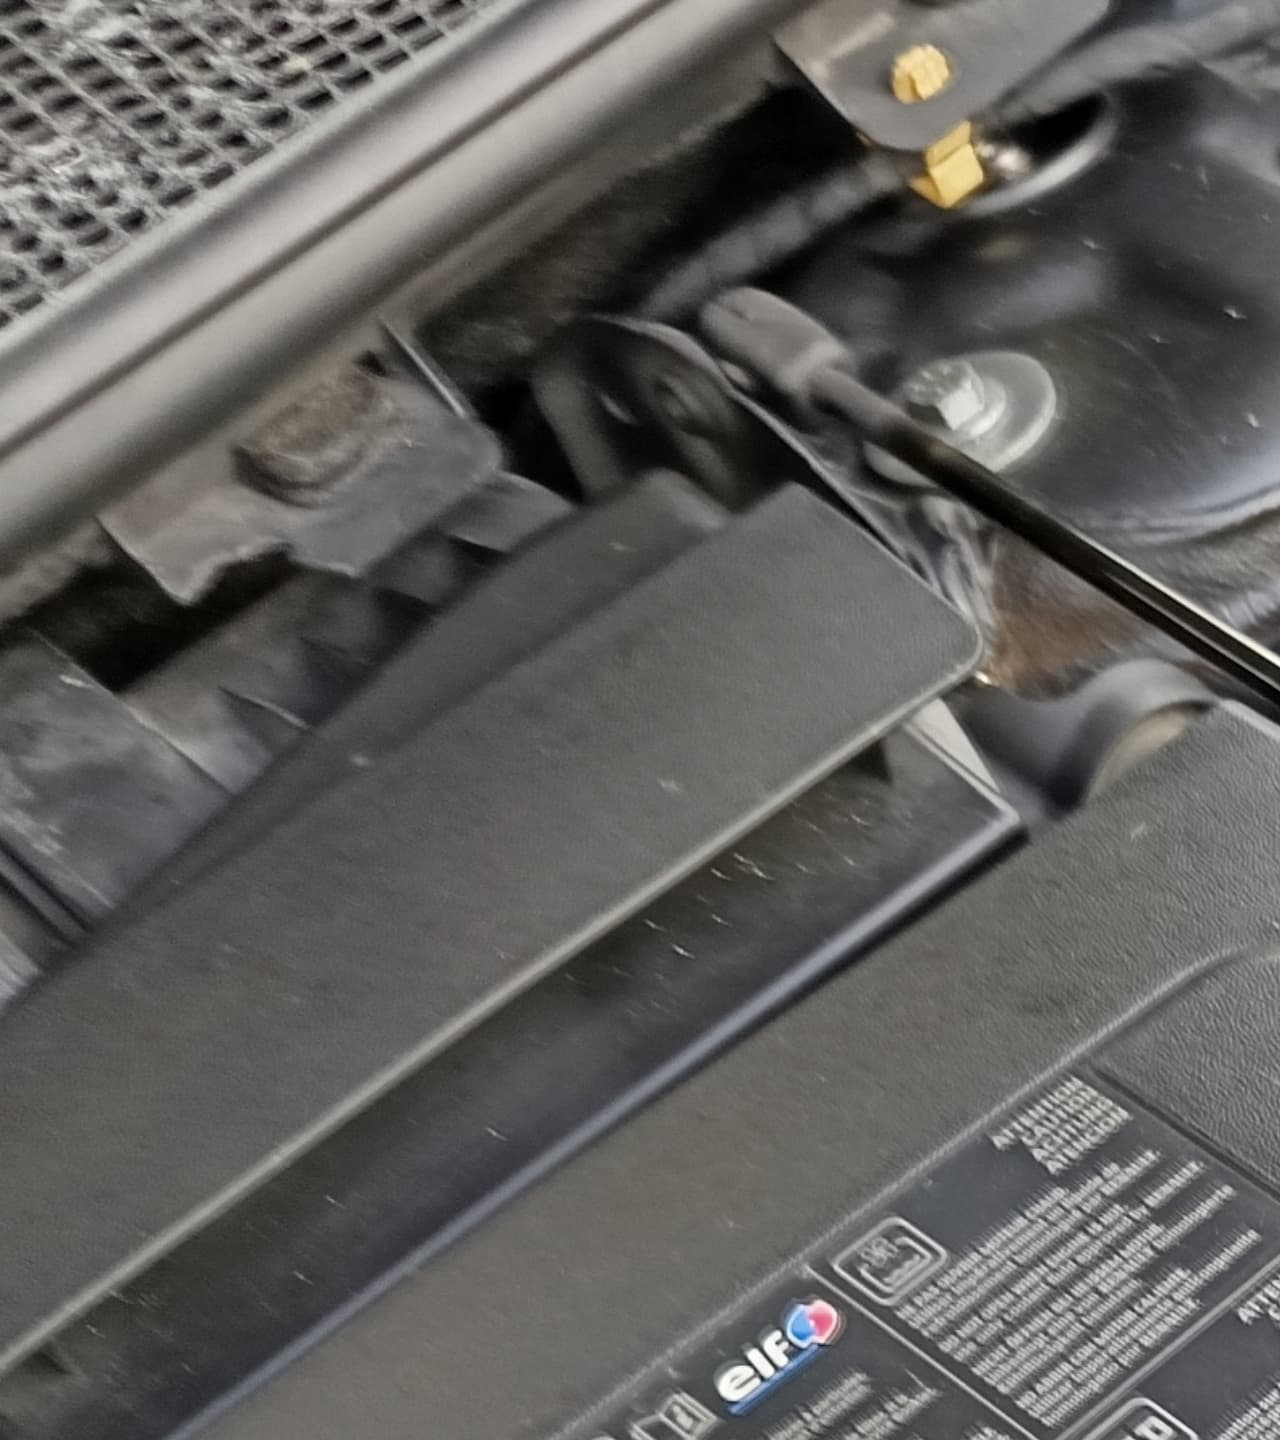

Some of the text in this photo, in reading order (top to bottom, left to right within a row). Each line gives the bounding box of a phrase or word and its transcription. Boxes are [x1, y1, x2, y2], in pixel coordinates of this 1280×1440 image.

[987, 1075, 1088, 1152] ATTENTION
[1018, 1085, 1101, 1148] CAUTION
[1028, 1095, 1117, 1163] ACHTUNG
[704, 1327, 805, 1406] elf
